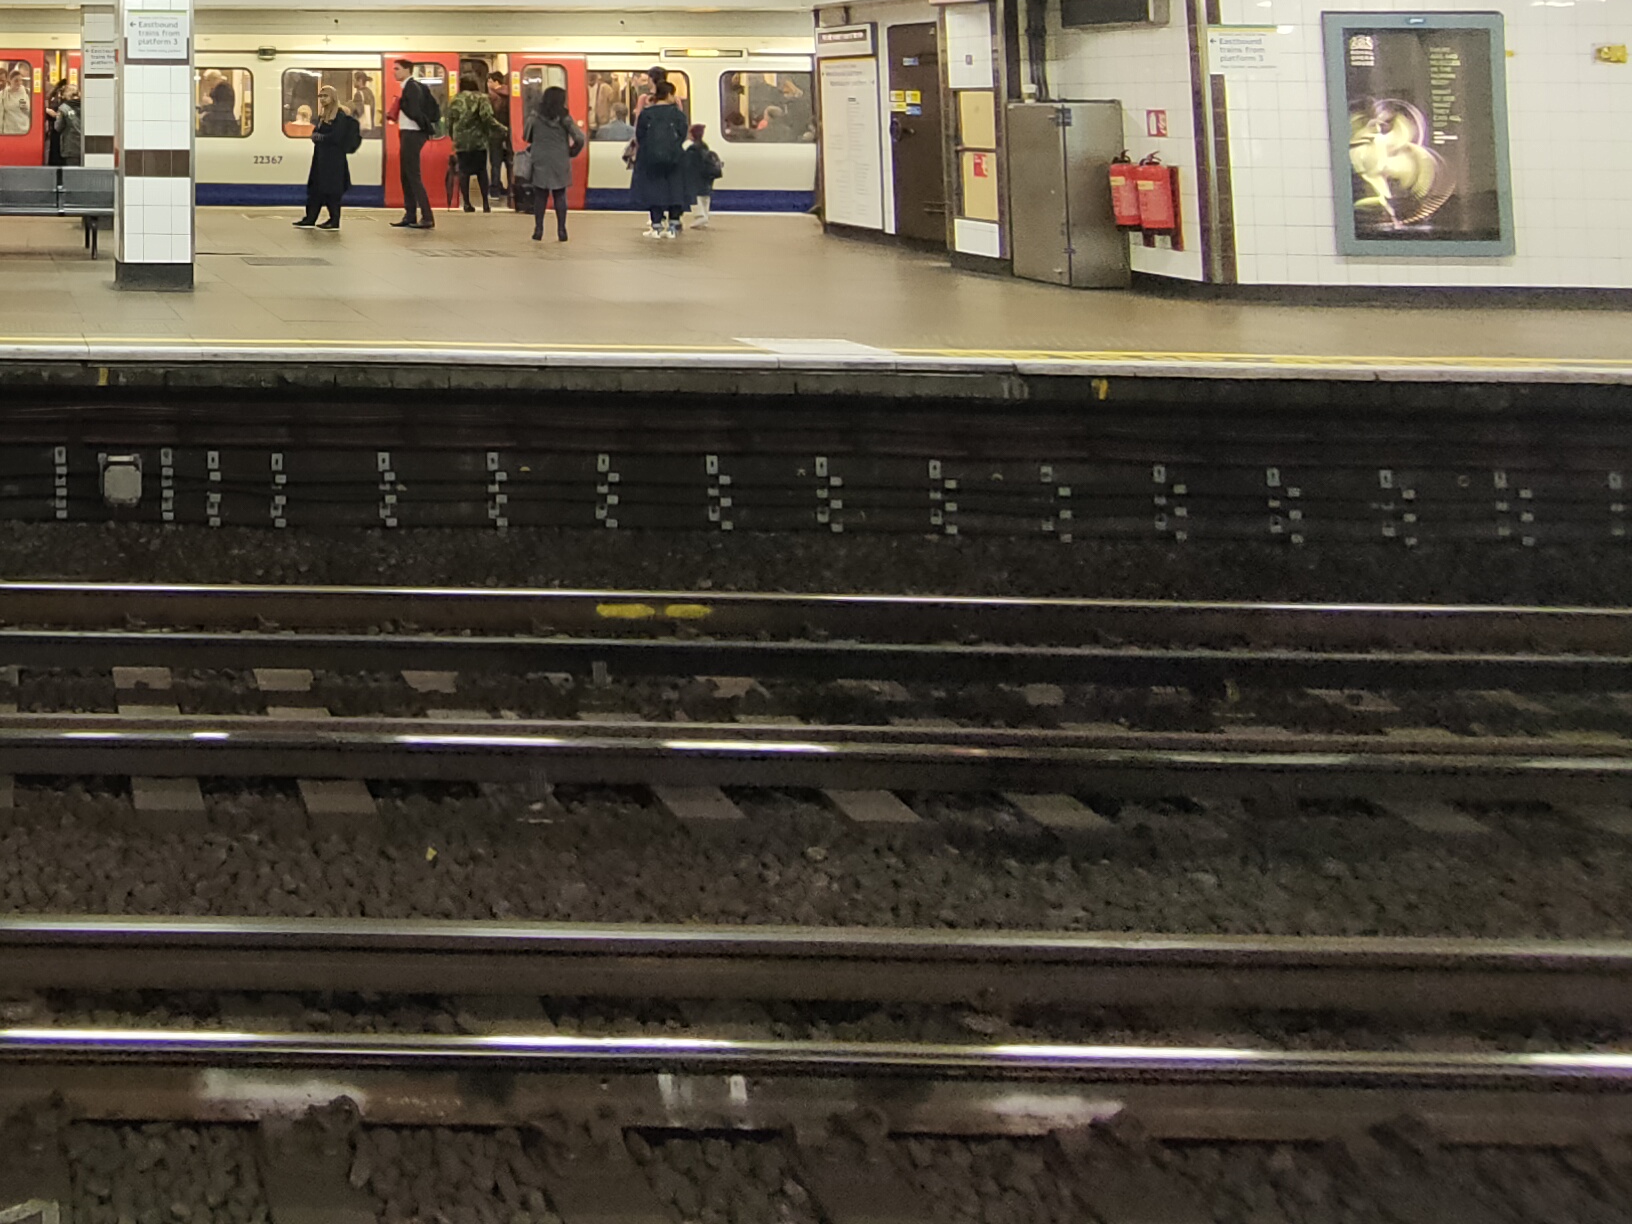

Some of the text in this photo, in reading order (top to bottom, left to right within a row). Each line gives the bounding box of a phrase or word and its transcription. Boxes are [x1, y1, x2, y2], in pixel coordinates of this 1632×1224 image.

[138, 21, 179, 29] Eastbound
[138, 29, 180, 37] trains from
[138, 38, 172, 46] platform
[1219, 37, 1262, 45] Eastbound
[1245, 46, 1265, 54] from
[253, 155, 283, 165] 22367
